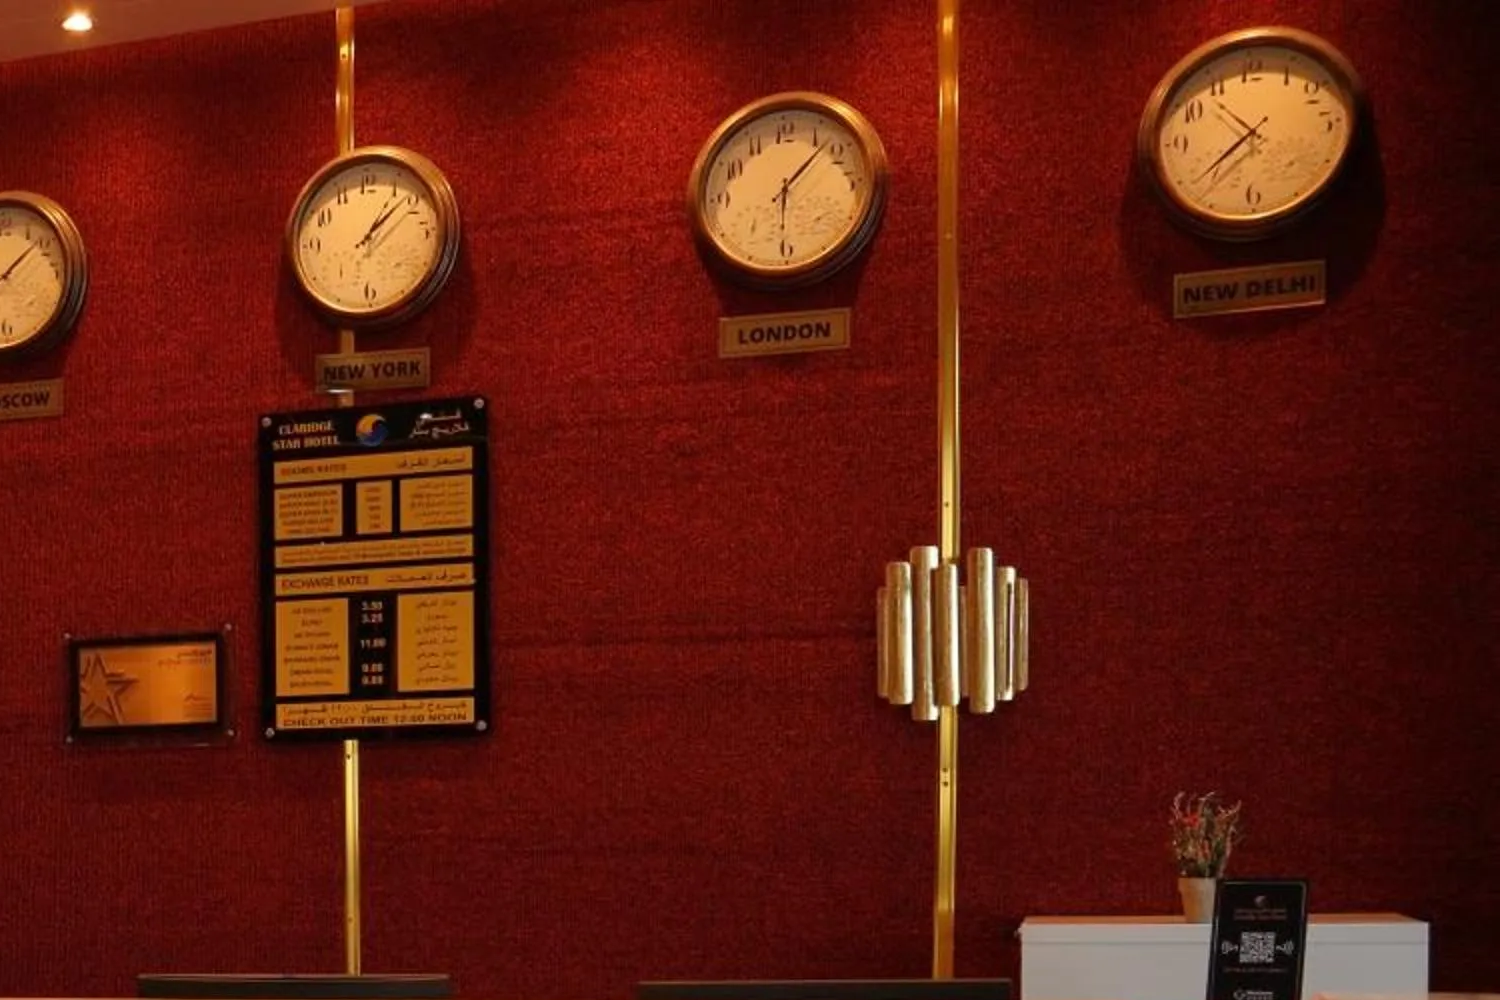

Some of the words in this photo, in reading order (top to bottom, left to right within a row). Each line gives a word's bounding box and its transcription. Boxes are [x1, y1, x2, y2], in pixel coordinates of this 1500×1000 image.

[1183, 282, 1239, 304] NEW
[1245, 274, 1316, 299] DELHI
[738, 321, 831, 345] LONDON
[323, 364, 366, 381] NEW
[371, 360, 421, 379] YORK
[272, 437, 302, 450] STAR
